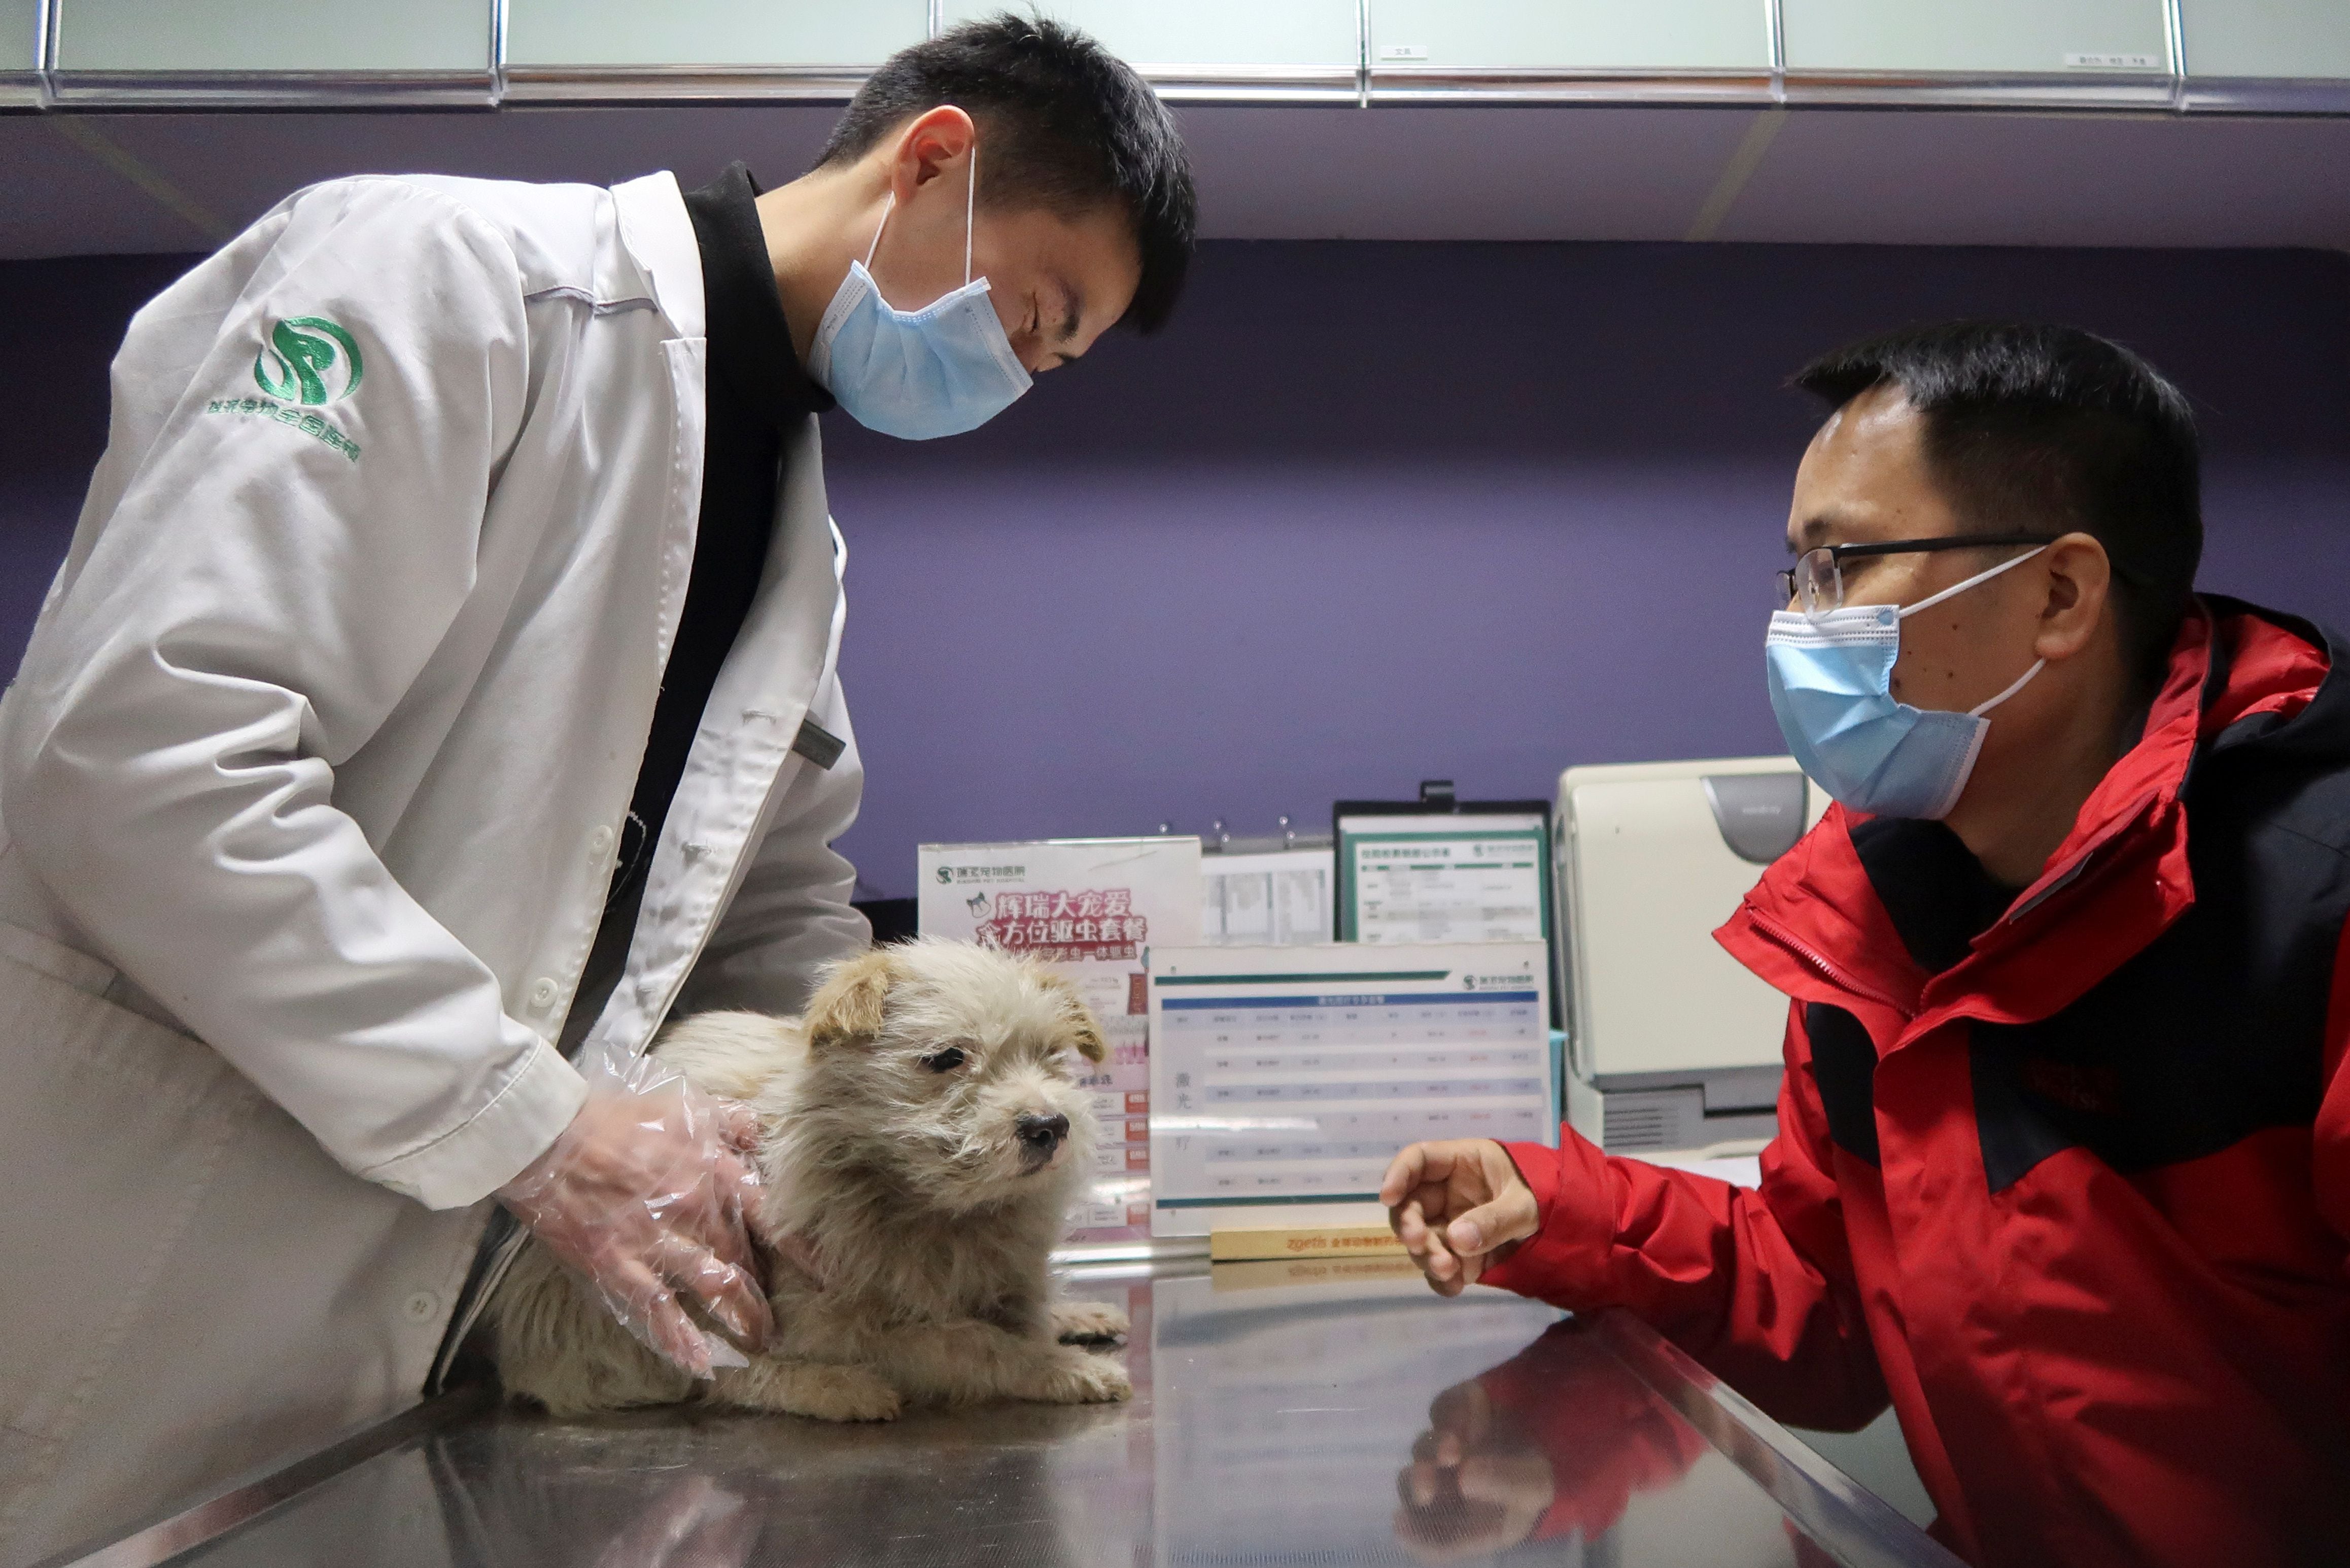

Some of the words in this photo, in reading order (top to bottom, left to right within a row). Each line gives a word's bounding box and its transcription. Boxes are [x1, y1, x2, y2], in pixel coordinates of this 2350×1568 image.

[997, 891, 1129, 919] 辉瑞大宠爱
